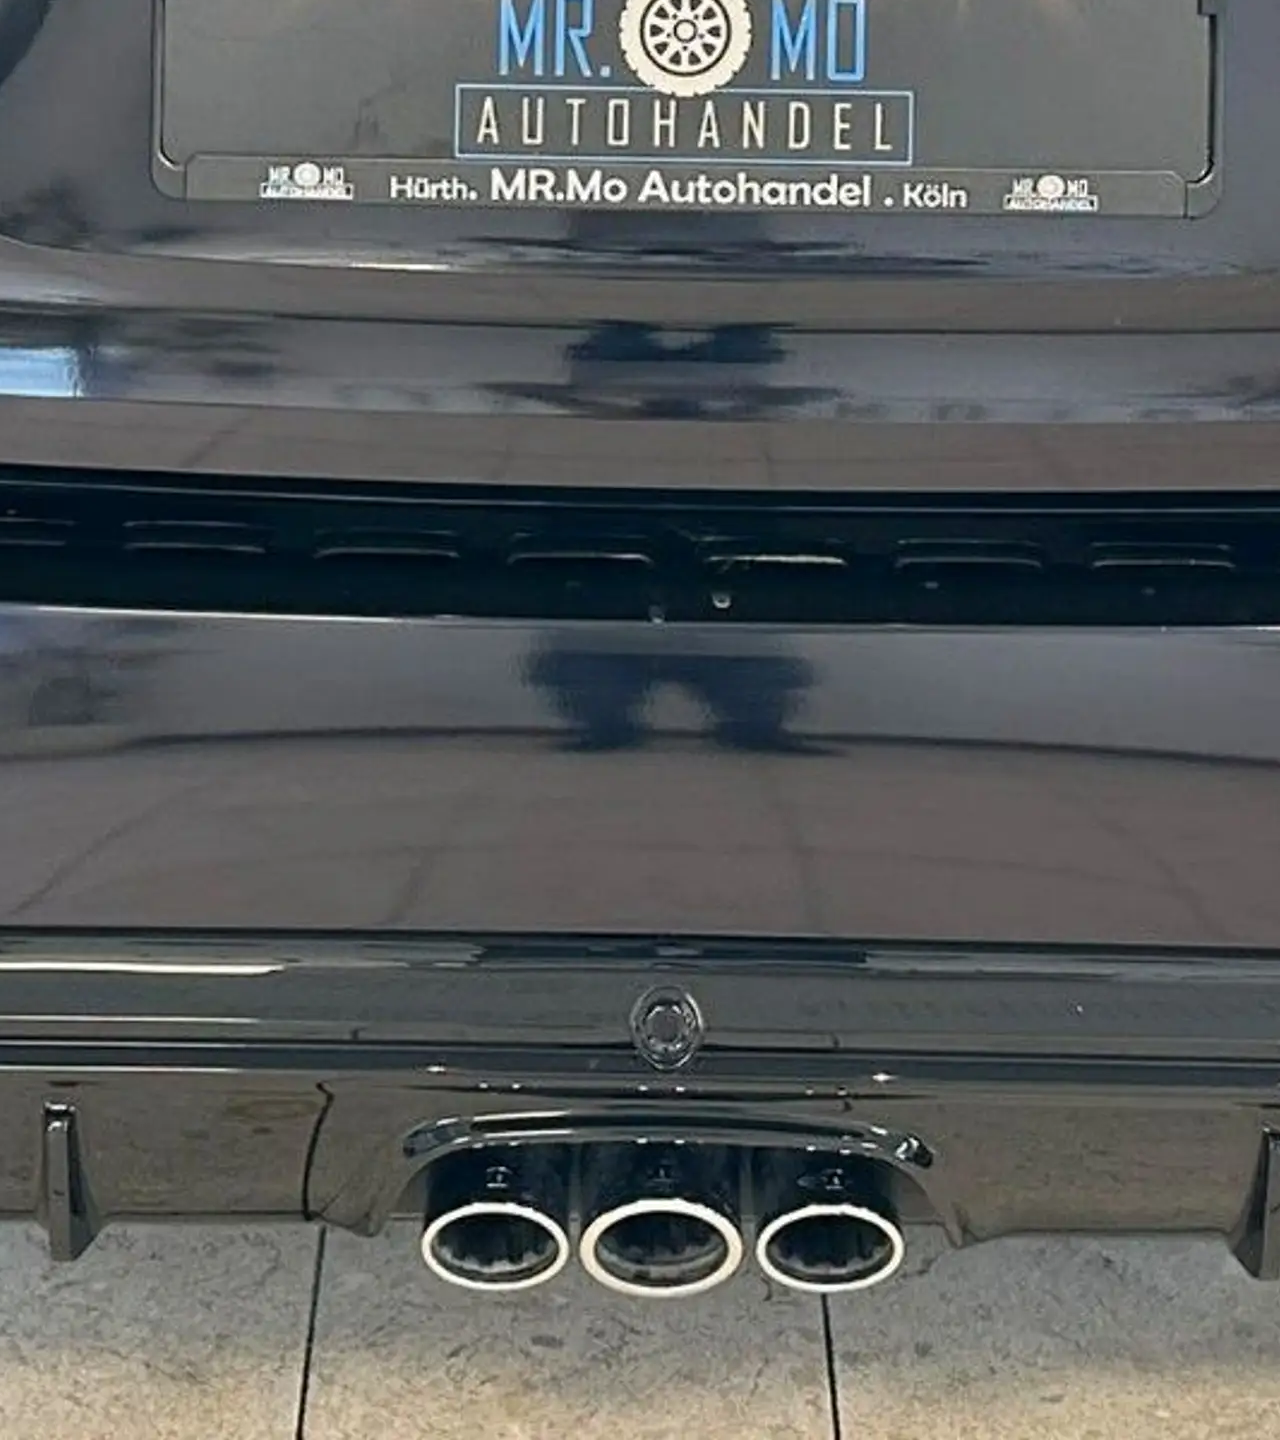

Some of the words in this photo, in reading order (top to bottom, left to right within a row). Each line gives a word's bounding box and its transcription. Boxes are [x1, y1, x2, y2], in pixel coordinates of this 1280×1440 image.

[476, 95, 894, 152] AUTOHANDEL
[490, 167, 628, 203] MR.Mo
[637, 170, 871, 208] Autohandel
[903, 182, 968, 209] Köln
